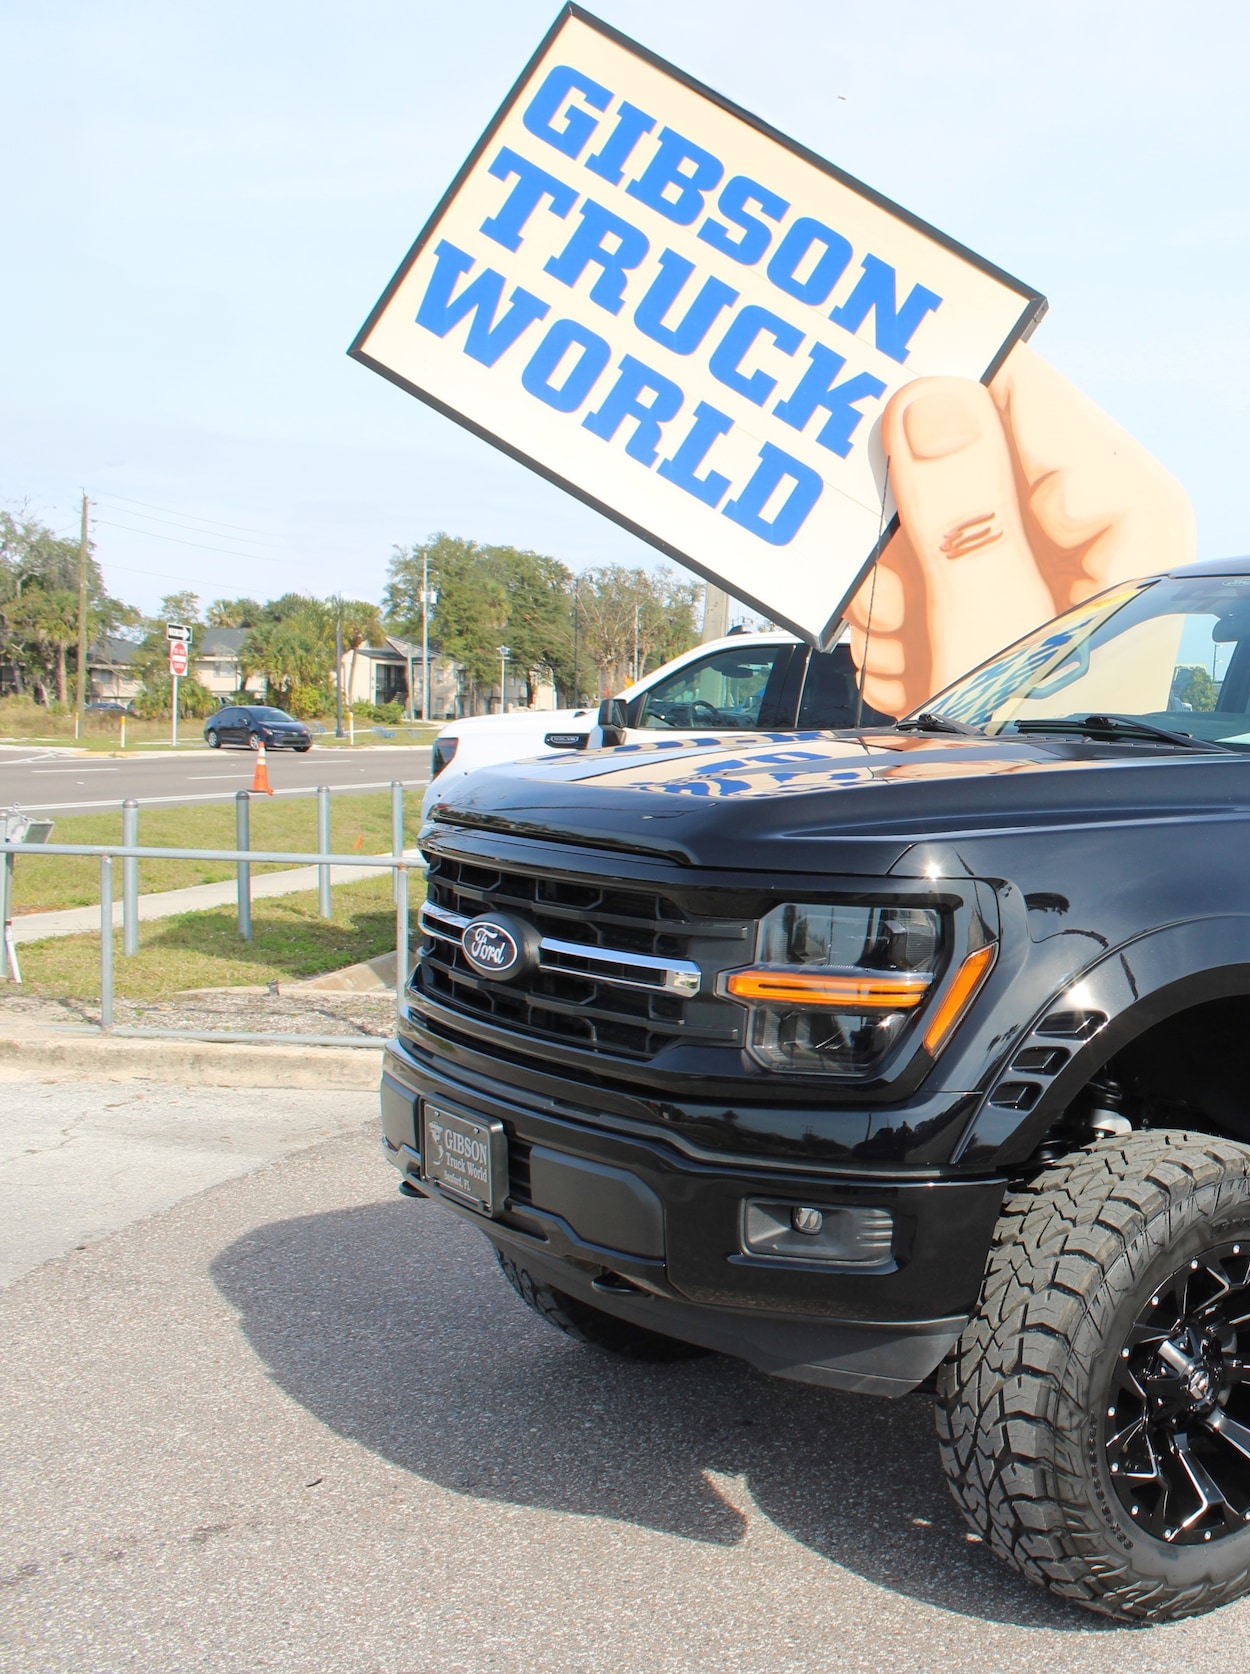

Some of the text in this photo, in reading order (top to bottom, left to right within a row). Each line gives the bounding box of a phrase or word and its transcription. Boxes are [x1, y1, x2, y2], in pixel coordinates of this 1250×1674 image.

[522, 65, 943, 364] GIBSON
[479, 146, 887, 458] TRUCK
[414, 239, 824, 546] WORLD
[471, 927, 506, 964] Ford
[445, 1128, 487, 1165] GIBSON
[446, 1152, 488, 1183] Truck World
